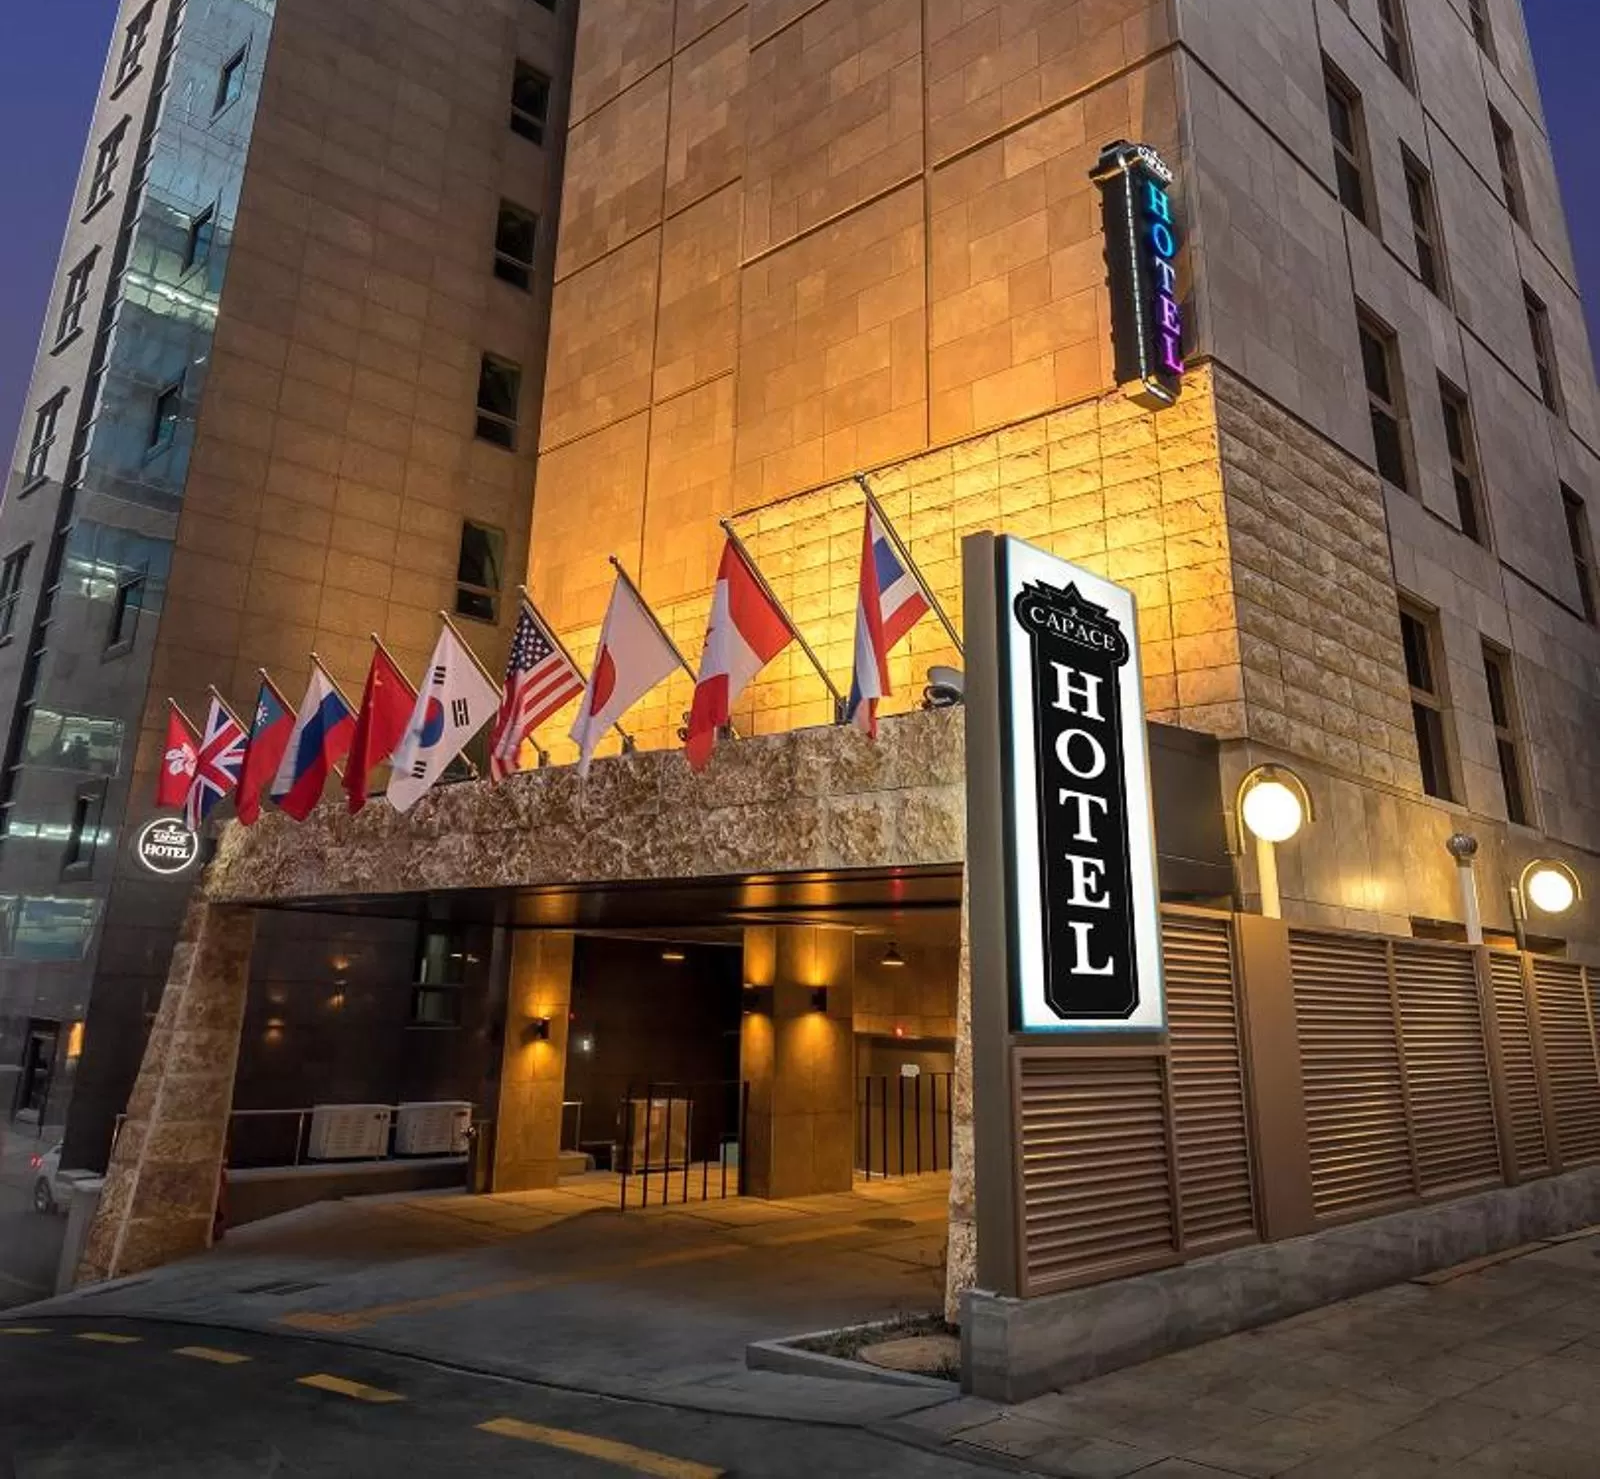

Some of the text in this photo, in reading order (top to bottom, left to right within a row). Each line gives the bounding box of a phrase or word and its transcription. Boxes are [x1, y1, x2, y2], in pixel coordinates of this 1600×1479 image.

[1147, 180, 1185, 375] HOTEL
[1030, 606, 1116, 652] CAPACE
[143, 843, 190, 858] HOTEL
[1050, 661, 1115, 976] HOTEL
